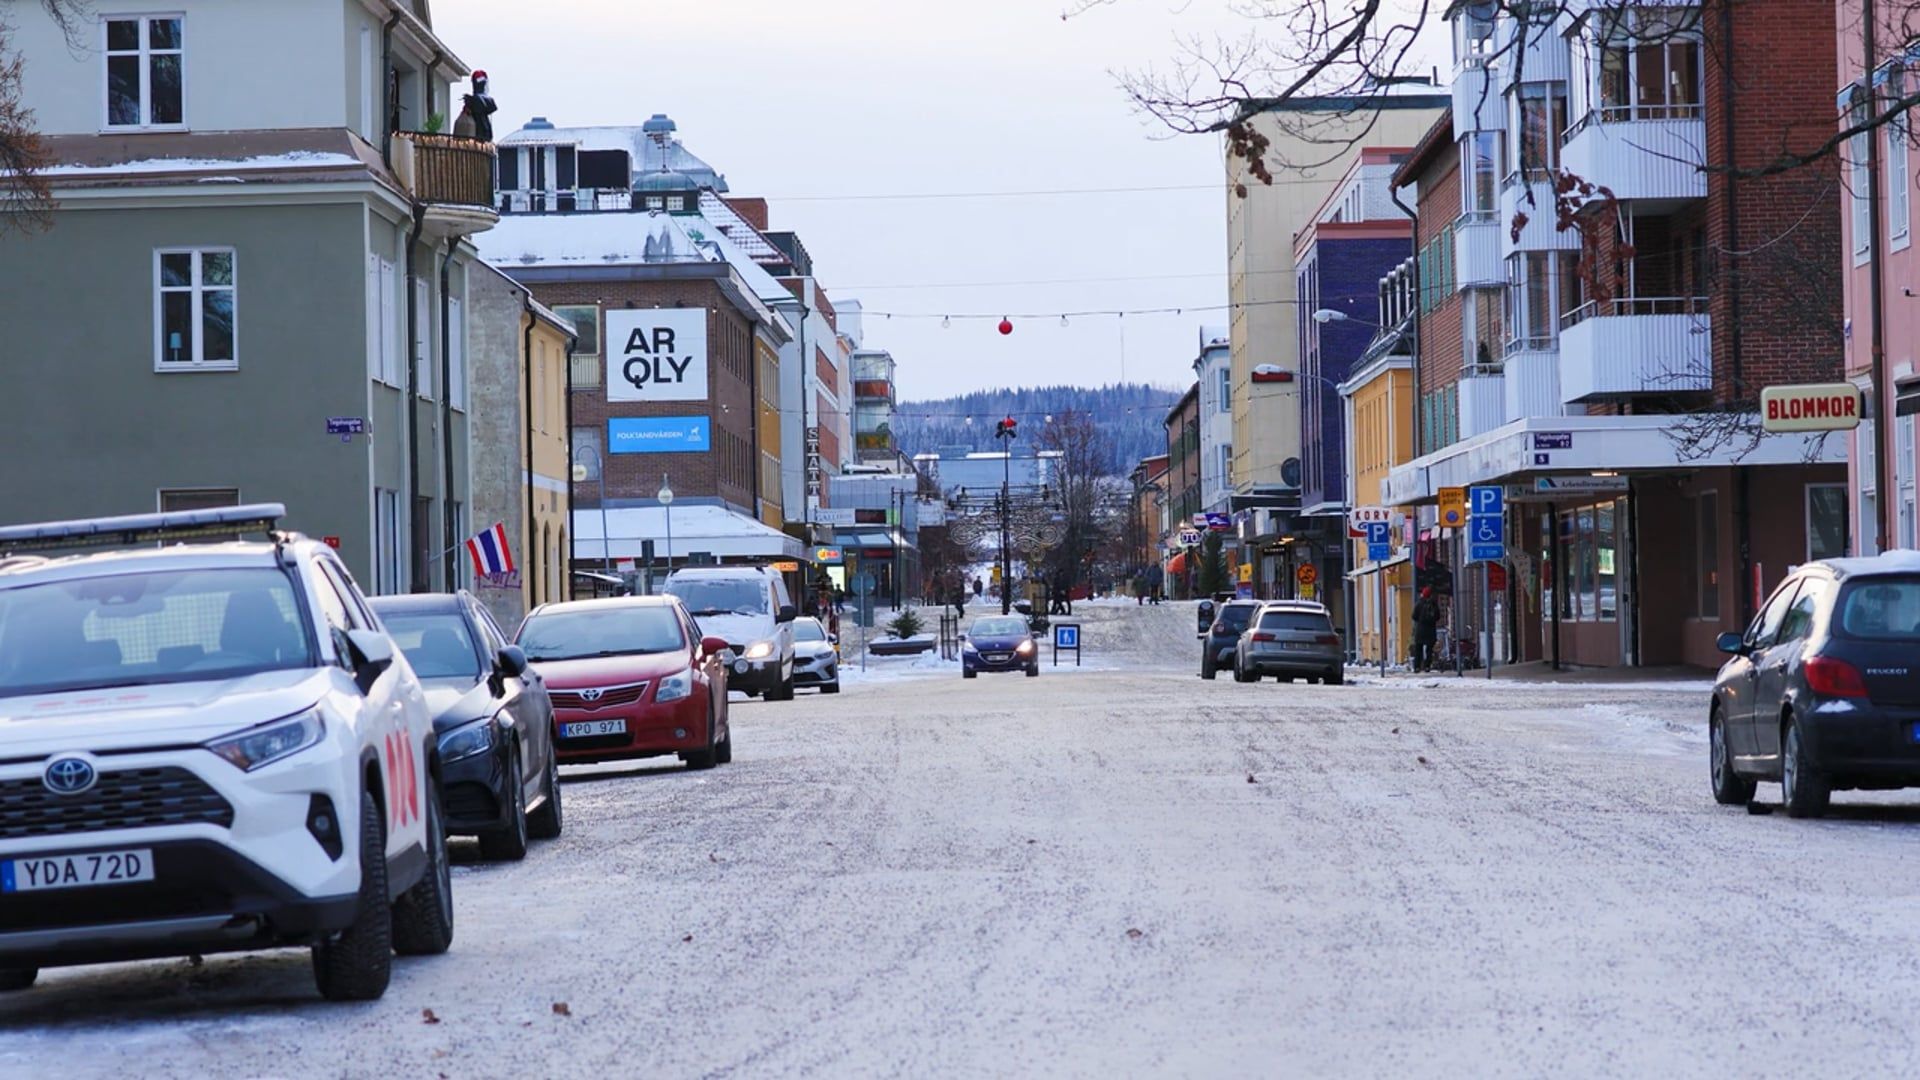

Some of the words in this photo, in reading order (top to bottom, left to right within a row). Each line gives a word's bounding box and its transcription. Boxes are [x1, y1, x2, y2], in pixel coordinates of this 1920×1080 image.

[623, 327, 676, 355] AR
[623, 355, 693, 390] QLY
[1767, 395, 1856, 420] BLOMMOR
[807, 428, 820, 496] STATT
[1481, 490, 1496, 512] P
[1355, 510, 1390, 520] KORV
[1373, 524, 1386, 542] P
[567, 723, 592, 736] KPO
[599, 721, 623, 733] 971
[24, 858, 79, 886] YDA
[86, 853, 142, 881] 72D
